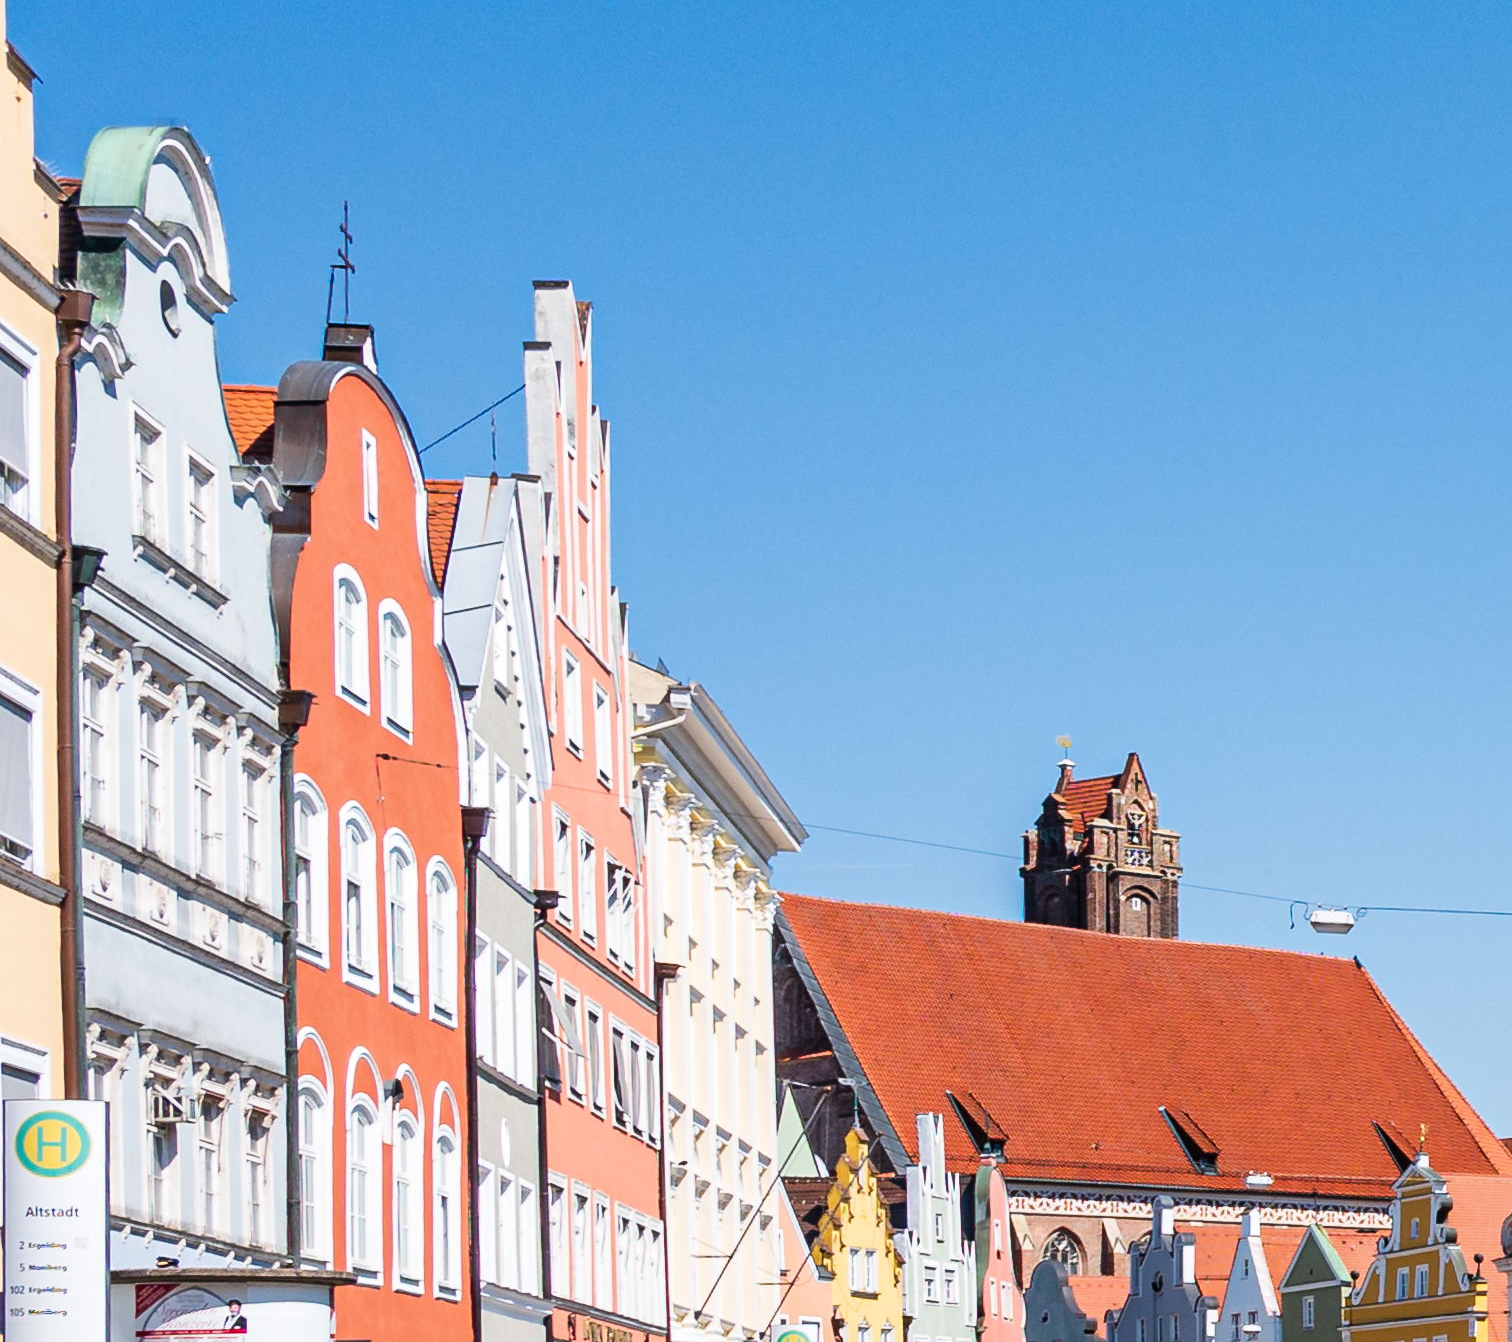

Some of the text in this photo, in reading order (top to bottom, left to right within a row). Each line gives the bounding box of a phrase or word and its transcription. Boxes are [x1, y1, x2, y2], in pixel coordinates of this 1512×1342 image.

[36, 1126, 67, 1162] H
[25, 1206, 79, 1218] Altstadt
[19, 1241, 25, 1250] 2
[19, 1263, 25, 1272] 5
[10, 1286, 25, 1294] 102
[10, 1308, 25, 1317] 105
